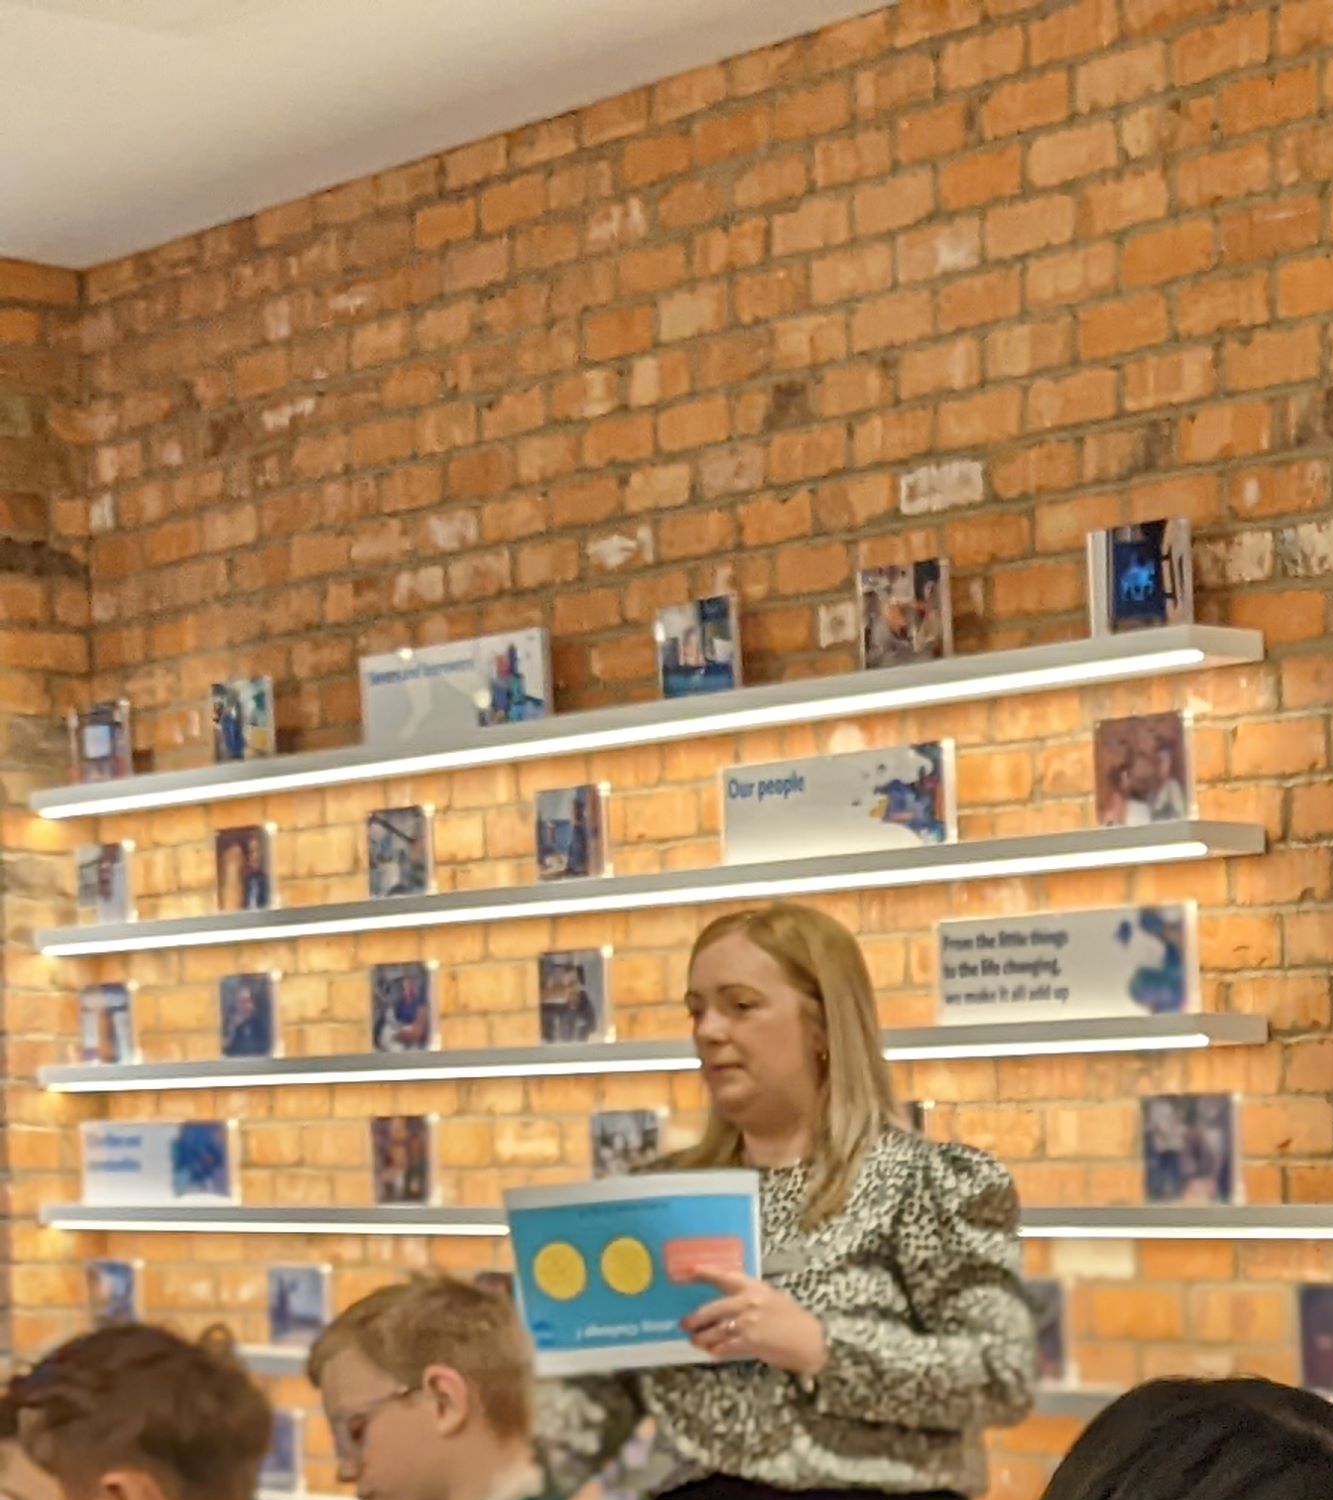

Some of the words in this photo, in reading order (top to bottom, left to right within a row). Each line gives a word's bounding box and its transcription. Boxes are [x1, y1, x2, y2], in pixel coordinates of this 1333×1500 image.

[728, 778, 754, 800] Our
[757, 770, 805, 803] people
[975, 931, 996, 950] the
[943, 965, 957, 980] to
[958, 961, 979, 979] the
